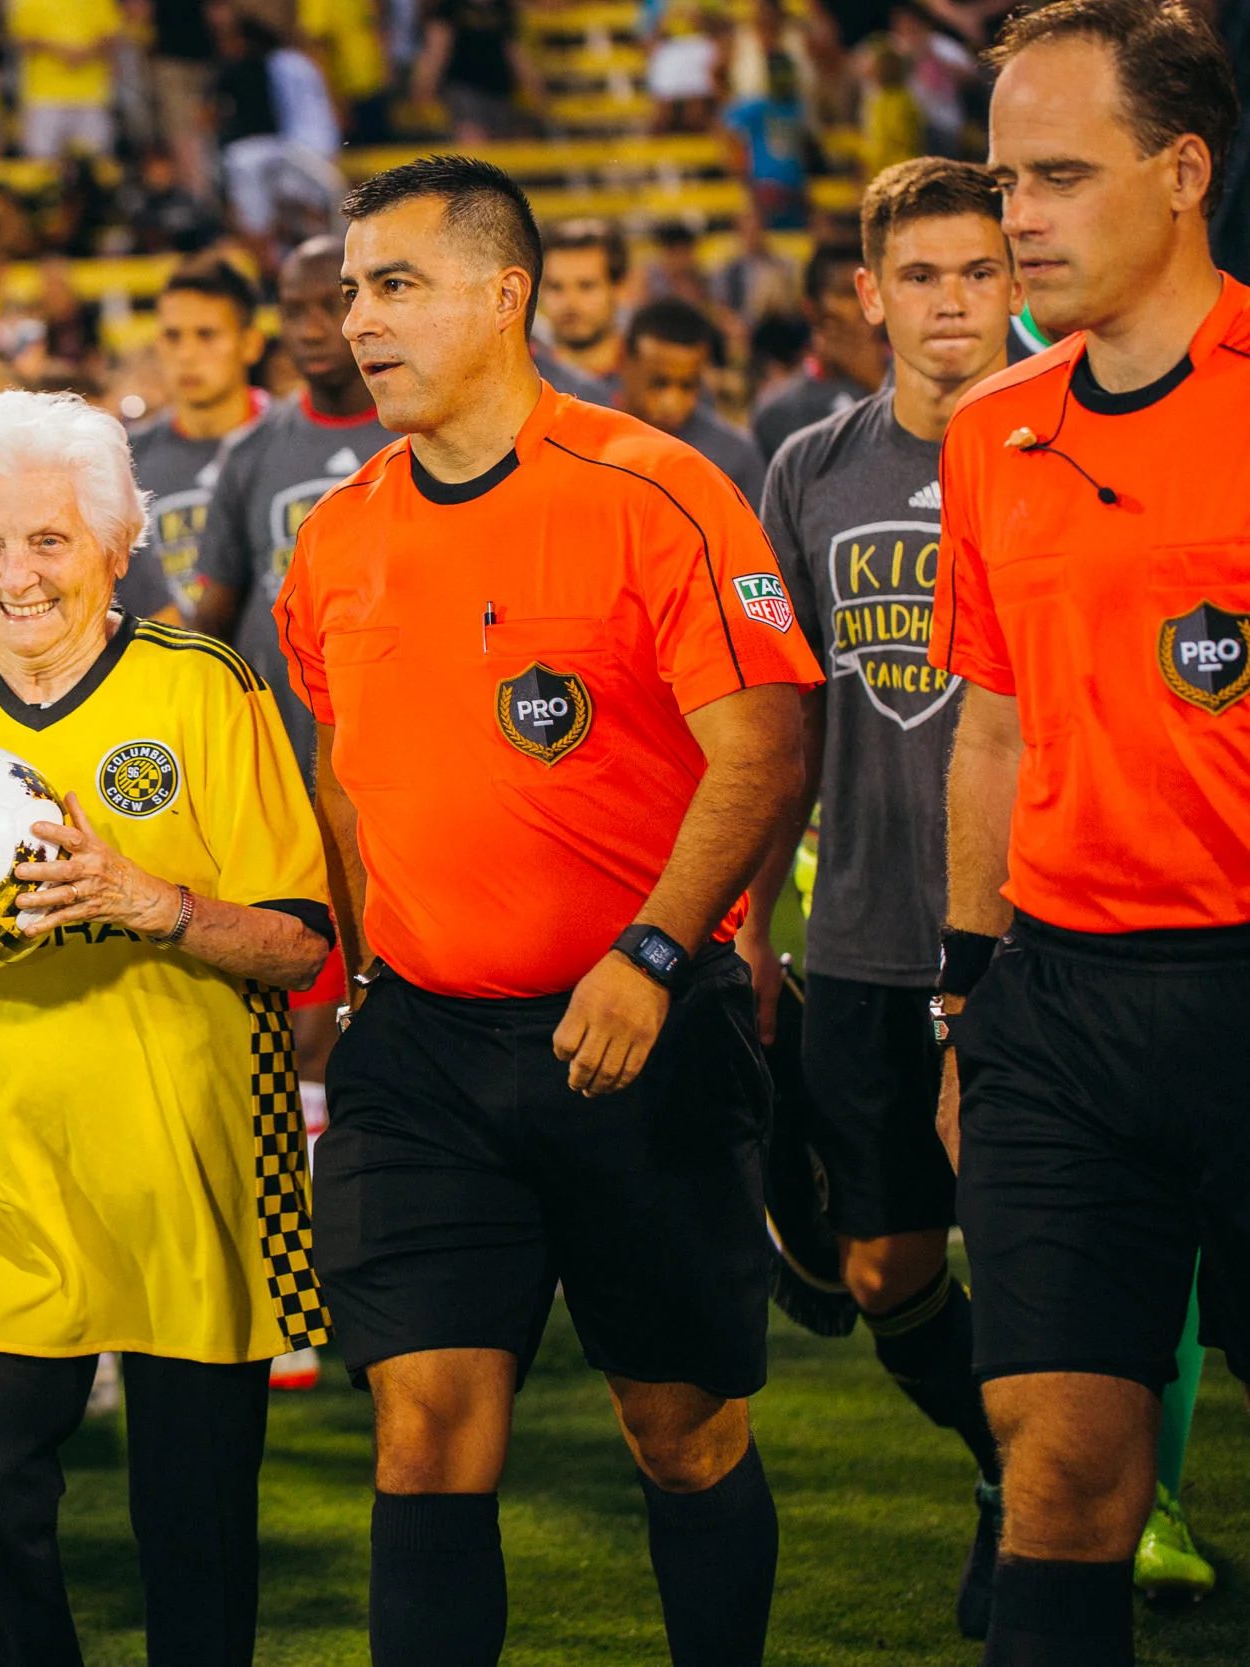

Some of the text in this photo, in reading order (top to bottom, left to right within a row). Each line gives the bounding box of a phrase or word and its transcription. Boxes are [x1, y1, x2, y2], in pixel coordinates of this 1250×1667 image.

[851, 541, 939, 593] KIC
[741, 578, 784, 597] TAG
[835, 603, 933, 648] CHILDH
[1180, 638, 1241, 665] PRO
[866, 660, 949, 693] CANCER
[517, 697, 568, 721] PRO
[106, 746, 172, 774] COLUMBUS
[127, 766, 140, 778] 96
[106, 786, 169, 812] CREW SC
